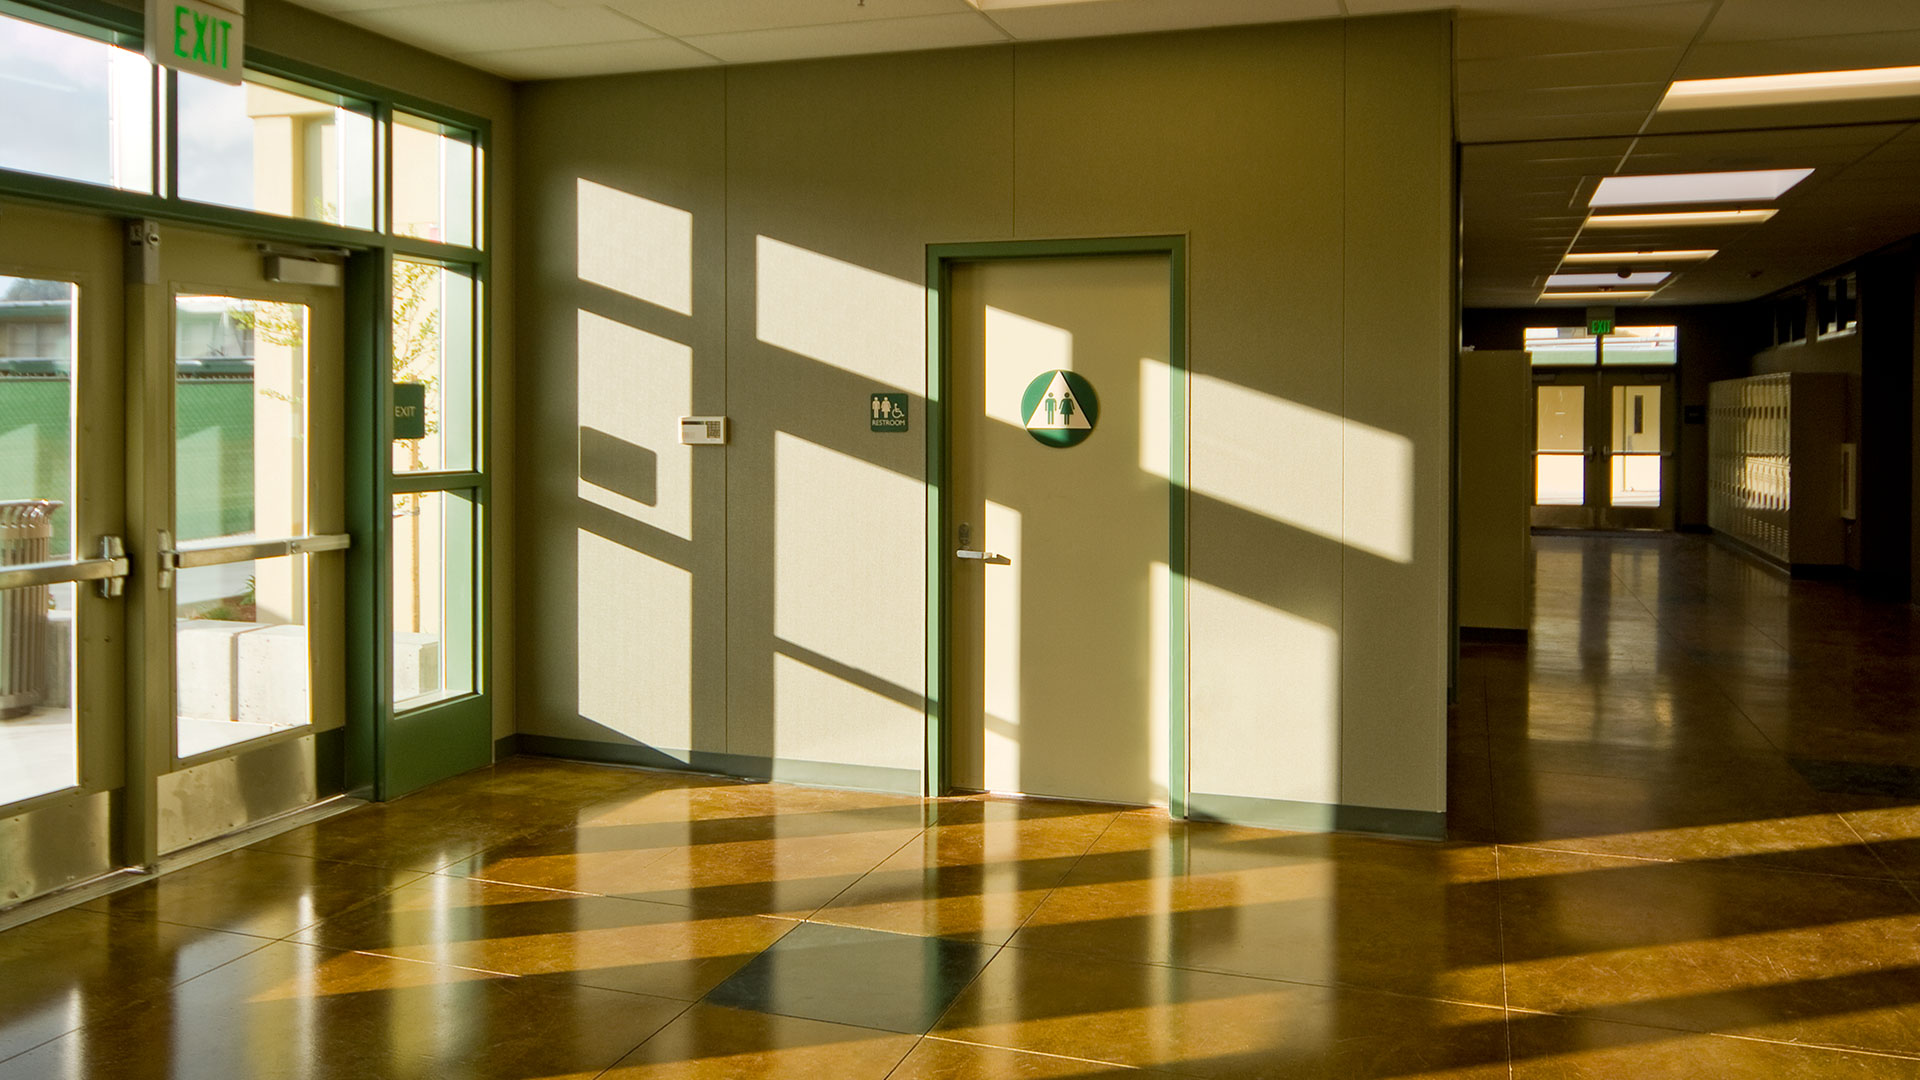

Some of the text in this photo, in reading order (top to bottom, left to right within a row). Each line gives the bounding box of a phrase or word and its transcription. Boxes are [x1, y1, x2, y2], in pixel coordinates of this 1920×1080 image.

[174, 5, 232, 70] EXIT
[1592, 320, 1611, 333] EXIT
[395, 405, 416, 417] EXIT
